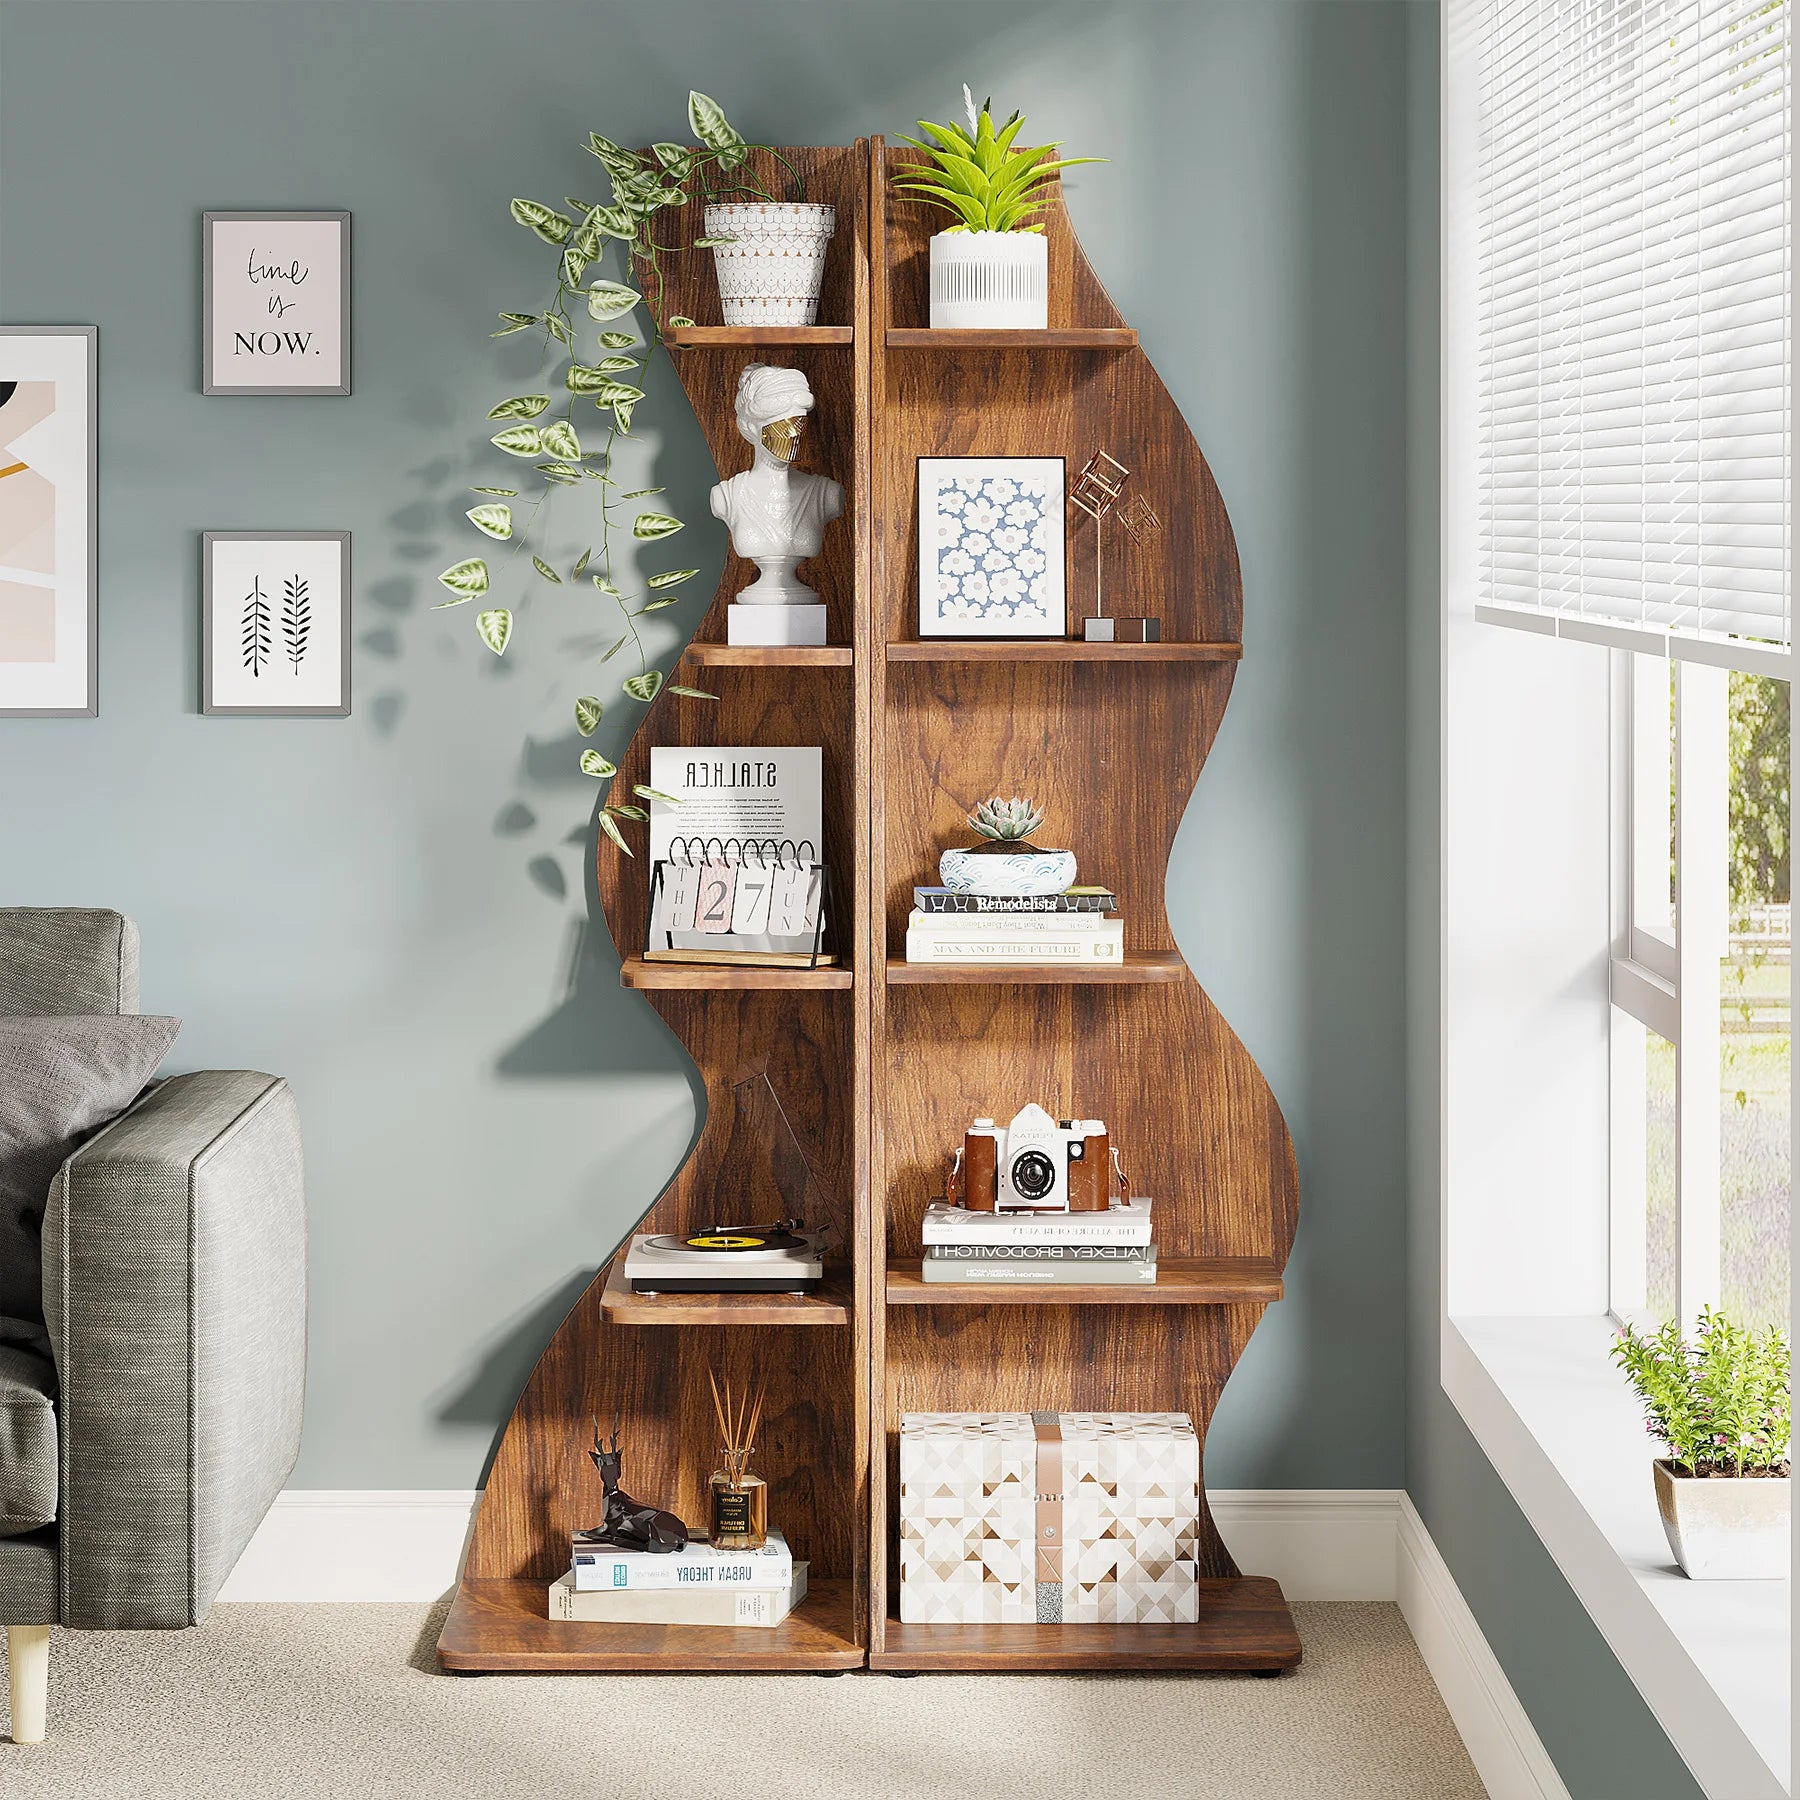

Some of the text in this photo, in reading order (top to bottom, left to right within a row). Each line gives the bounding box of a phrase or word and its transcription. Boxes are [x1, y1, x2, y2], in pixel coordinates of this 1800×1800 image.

[247, 248, 308, 284] time
[268, 289, 296, 318] is
[233, 332, 320, 355] NOW.
[976, 895, 1059, 910] Remodelista
[934, 945, 1081, 954] MAN AND THE FUTURE
